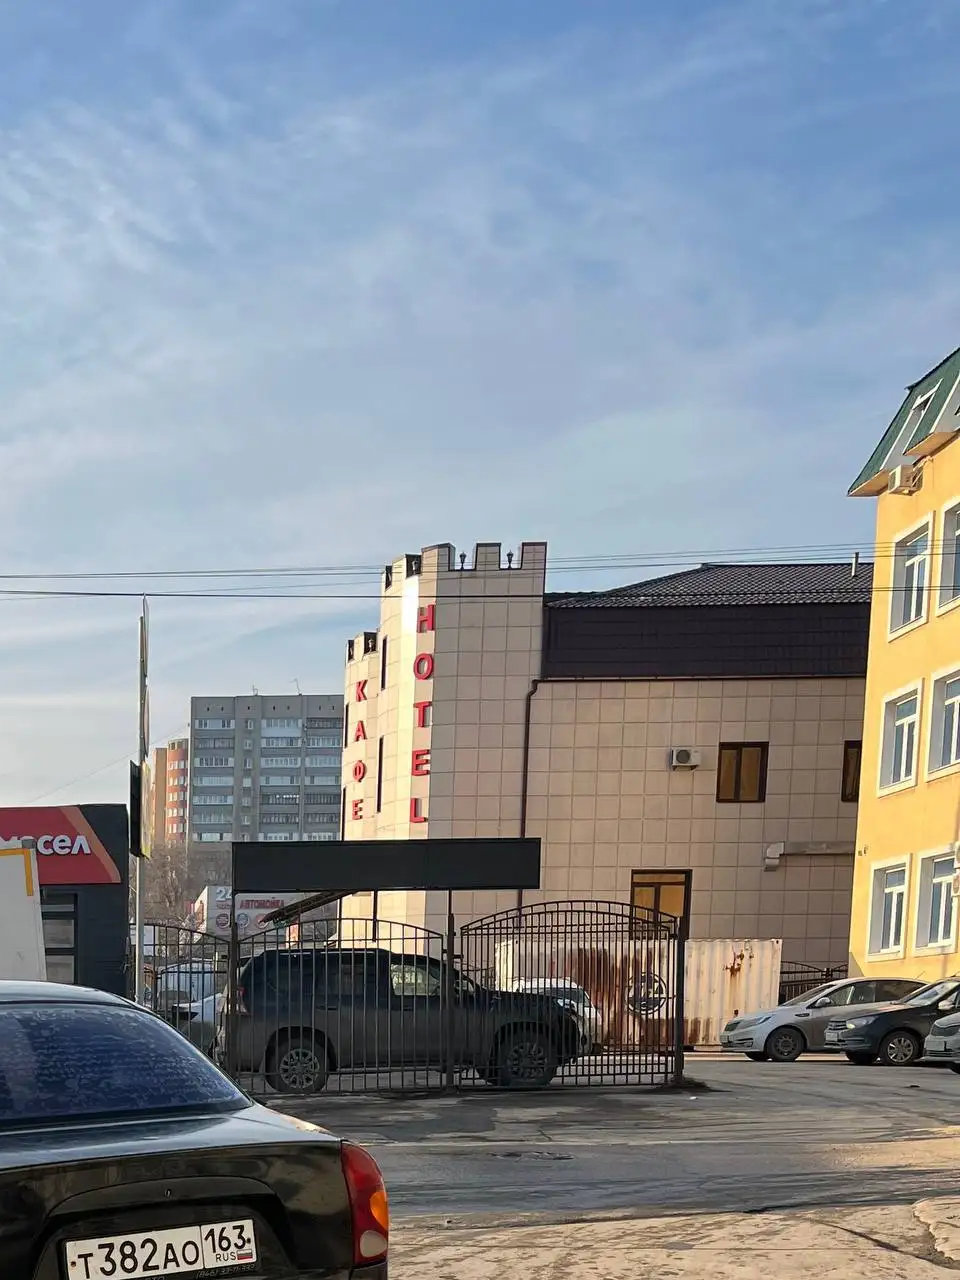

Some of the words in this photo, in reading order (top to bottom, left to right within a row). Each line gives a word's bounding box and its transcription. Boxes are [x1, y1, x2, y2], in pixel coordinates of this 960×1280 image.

[352, 679, 368, 820] КАФЕ
[410, 603, 436, 824] HOTEL
[204, 1225, 245, 1254] 163
[215, 1252, 237, 1263] RUS
